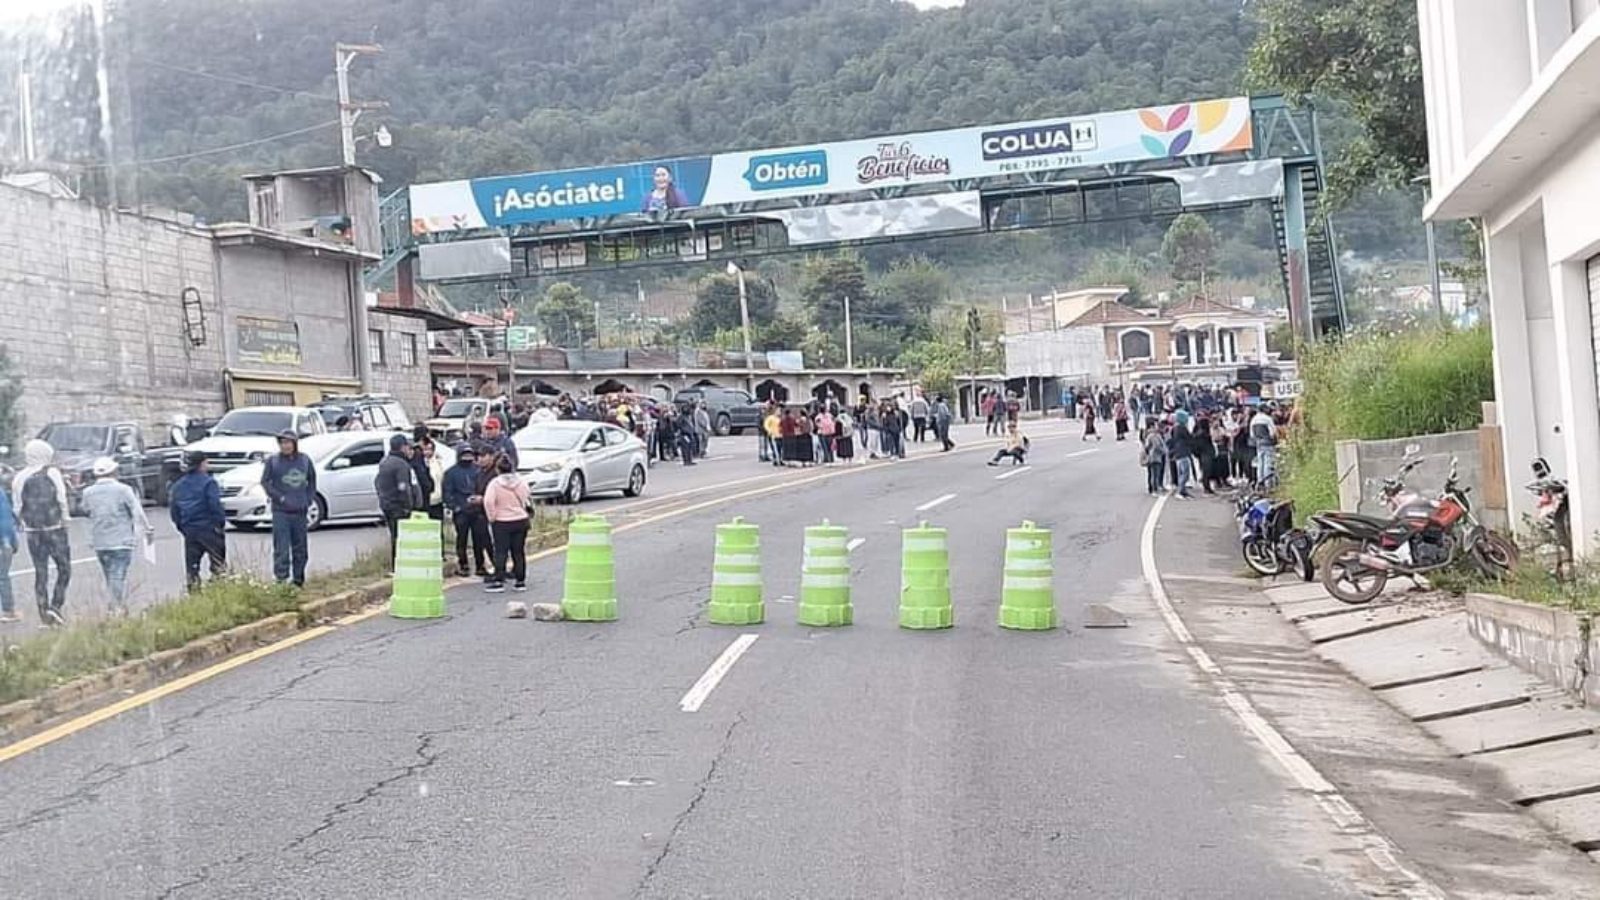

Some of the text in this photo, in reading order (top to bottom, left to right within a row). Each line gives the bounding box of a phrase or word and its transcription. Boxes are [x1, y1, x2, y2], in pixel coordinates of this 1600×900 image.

[983, 130, 1071, 154] COLUA
[755, 160, 821, 183] Obtén
[857, 154, 951, 184] Beneficios
[494, 177, 625, 218] ¡Asóciate!
